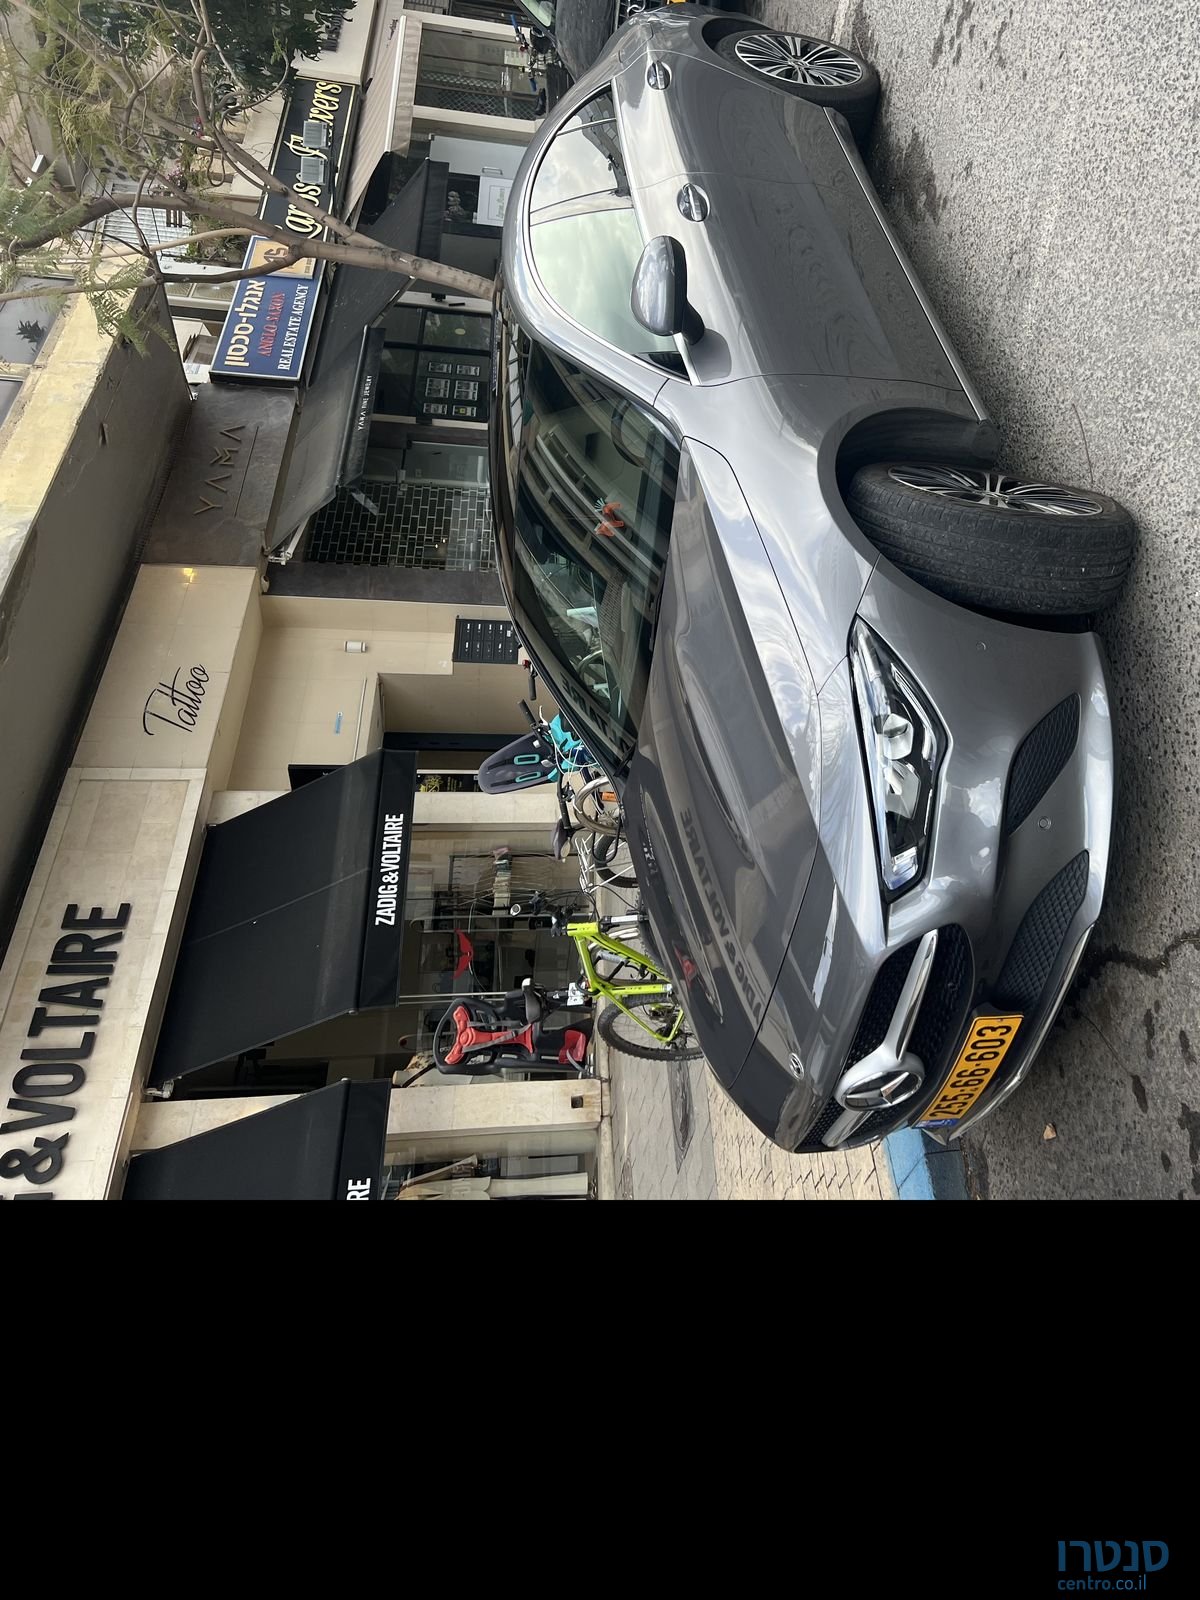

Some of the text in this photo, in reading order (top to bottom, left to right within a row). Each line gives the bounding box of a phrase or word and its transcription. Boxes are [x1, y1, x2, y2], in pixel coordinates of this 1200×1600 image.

[224, 279, 266, 366] אנגלו-סכסון
[258, 292, 286, 356] ANGLO-SAXON
[281, 315, 302, 348] ESTATE
[290, 284, 309, 316] AGENCY
[278, 347, 294, 370] REAL
[193, 425, 246, 514] YAMA
[142, 664, 210, 736] Tattoo
